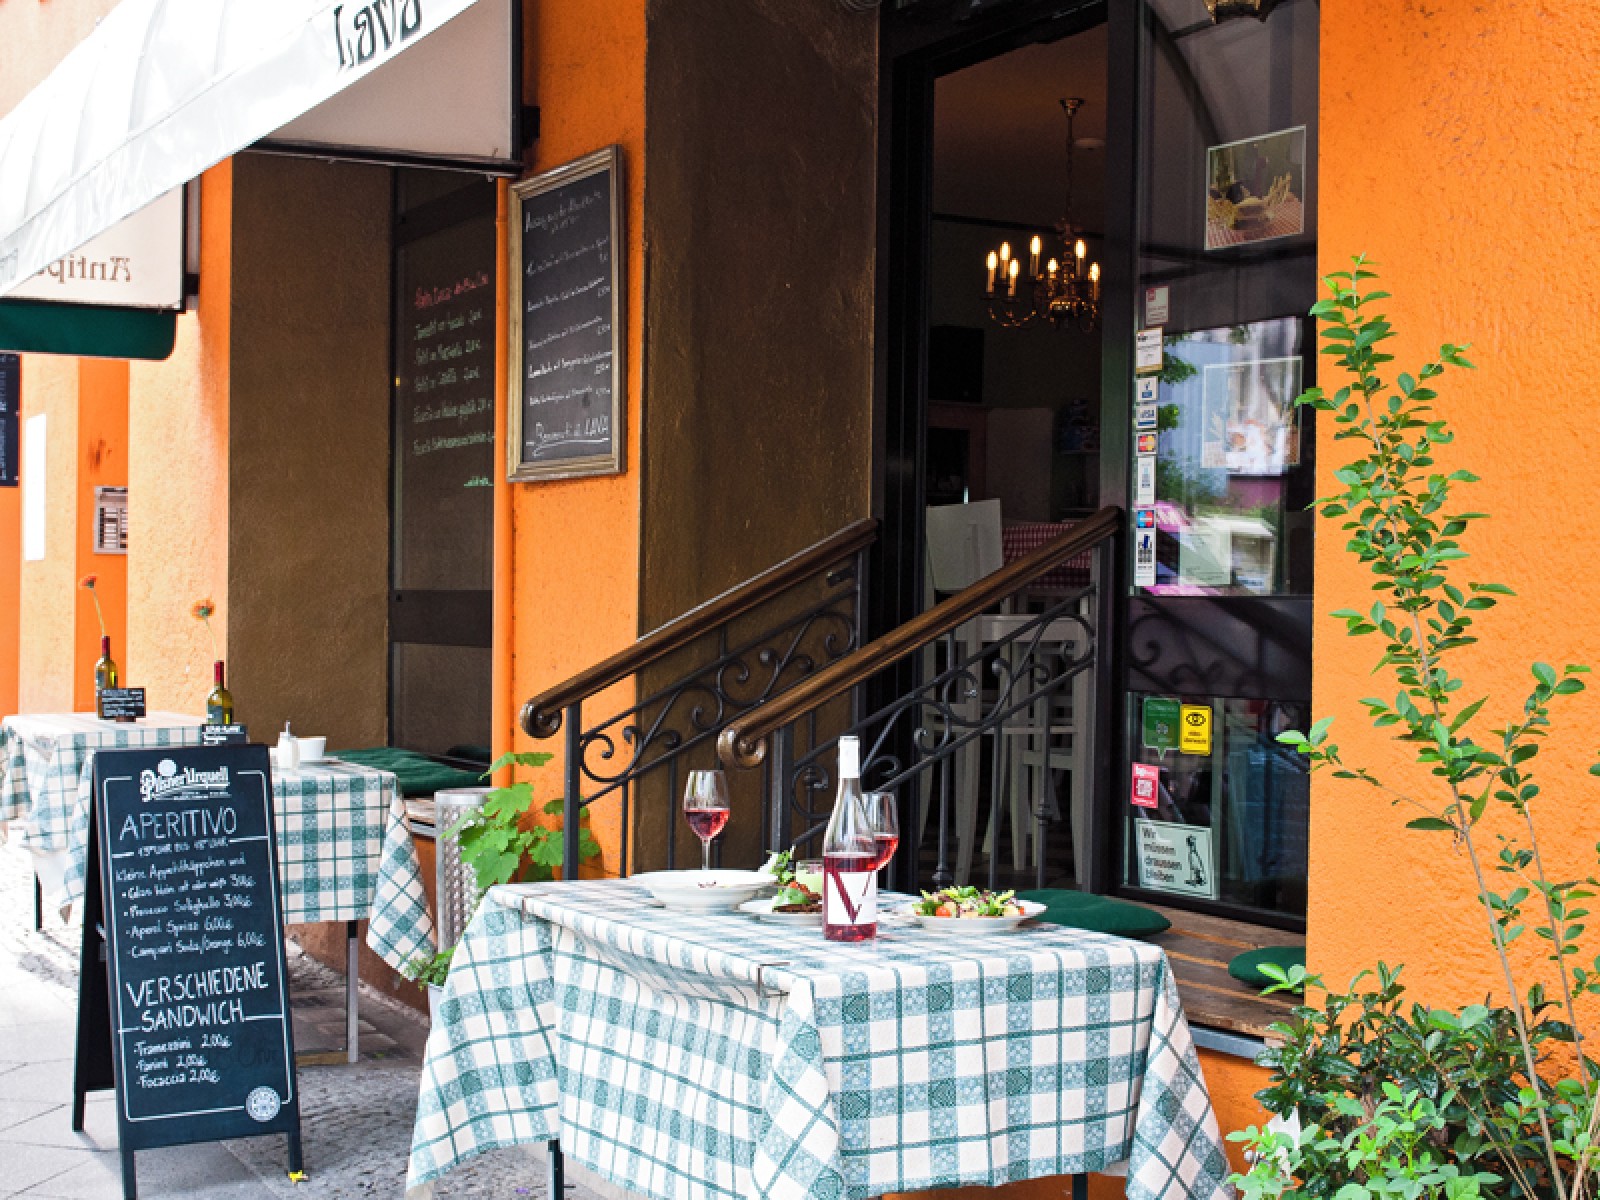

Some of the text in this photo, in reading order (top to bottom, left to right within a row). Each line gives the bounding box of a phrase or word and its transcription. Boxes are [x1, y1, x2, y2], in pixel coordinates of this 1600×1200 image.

[333, 0, 422, 68] Lava
[139, 766, 229, 802] Pilsner Urquell
[118, 805, 237, 841] APERITIVO
[1141, 827, 1157, 838] Wir
[227, 851, 246, 866] und
[1143, 841, 1177, 856] müssen
[1144, 855, 1183, 871] draussen
[1145, 868, 1175, 883] bleiben
[125, 961, 269, 1009] VERSCHIEDENE
[141, 997, 245, 1033] SANDWICH
